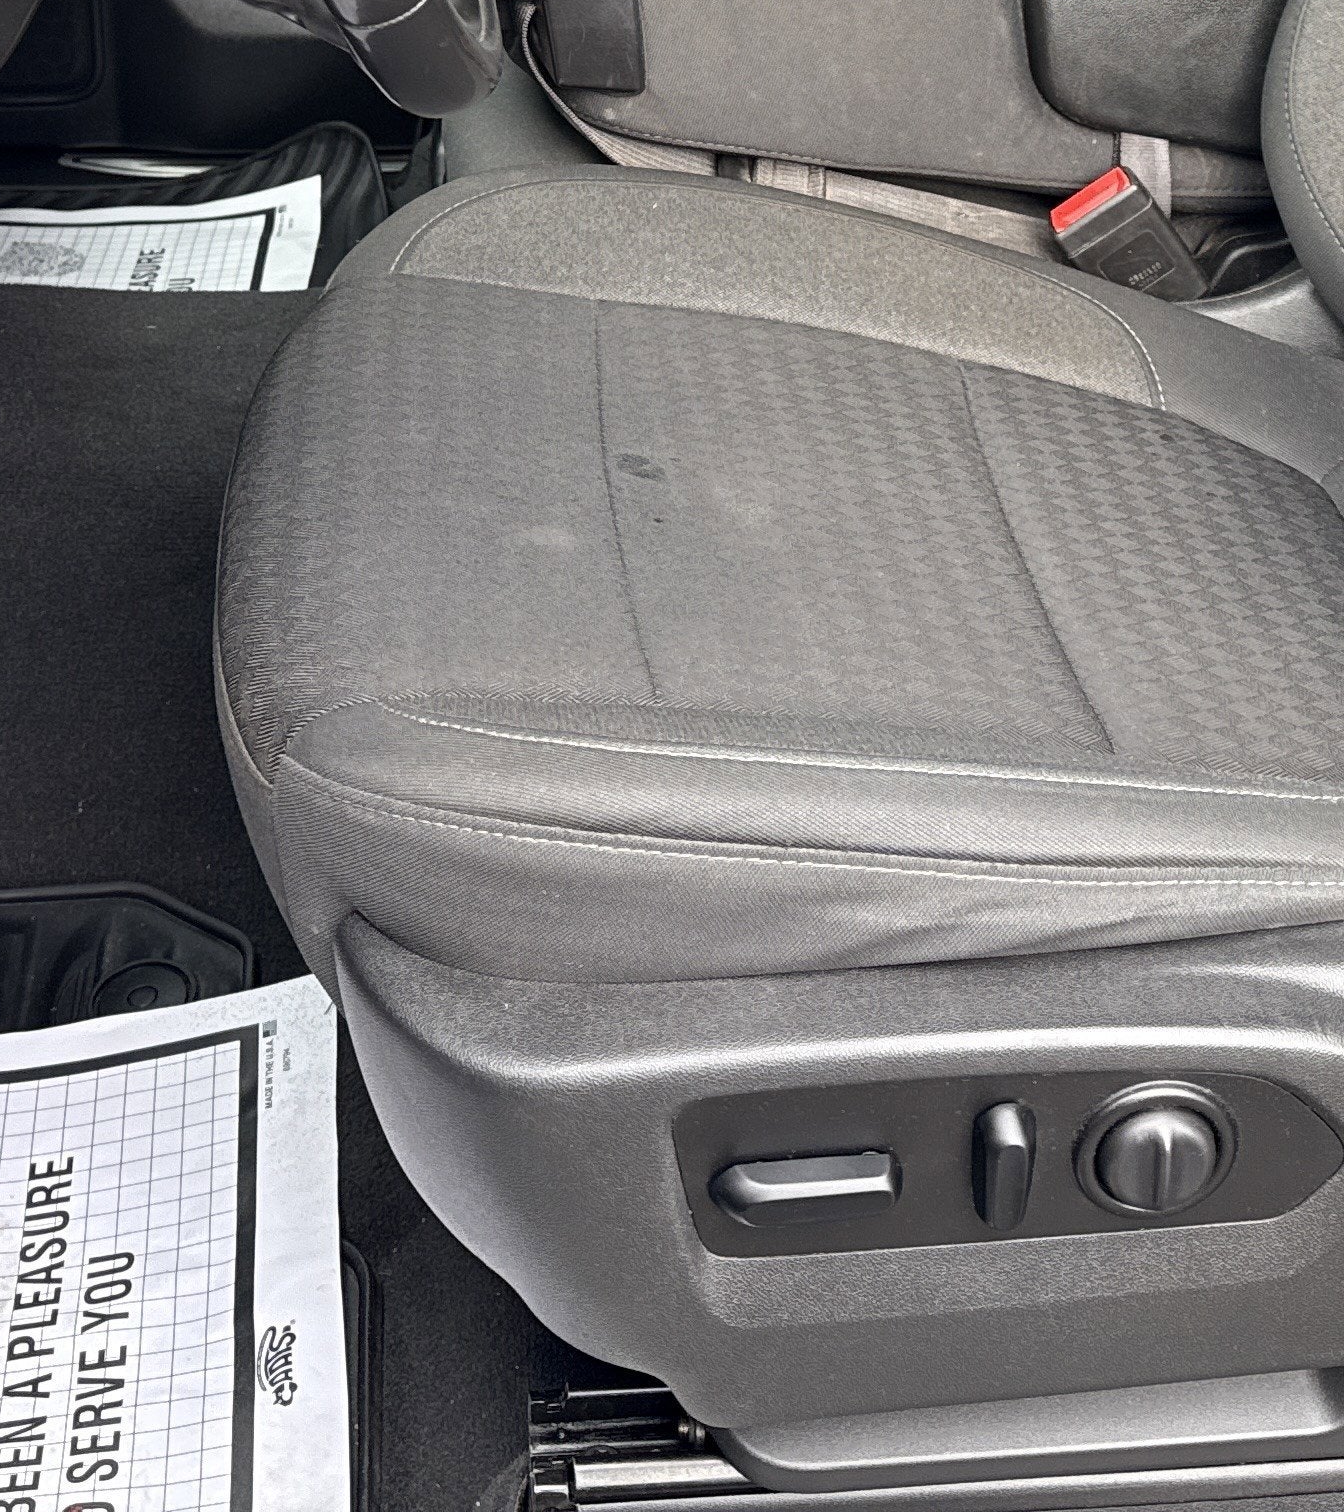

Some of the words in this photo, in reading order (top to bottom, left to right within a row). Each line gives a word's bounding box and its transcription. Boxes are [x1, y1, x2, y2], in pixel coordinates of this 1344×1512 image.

[6, 1156, 74, 1362] PLEASURE
[81, 1251, 135, 1335] YOU
[2, 1373, 52, 1399] A
[65, 1345, 127, 1484] SERVE
